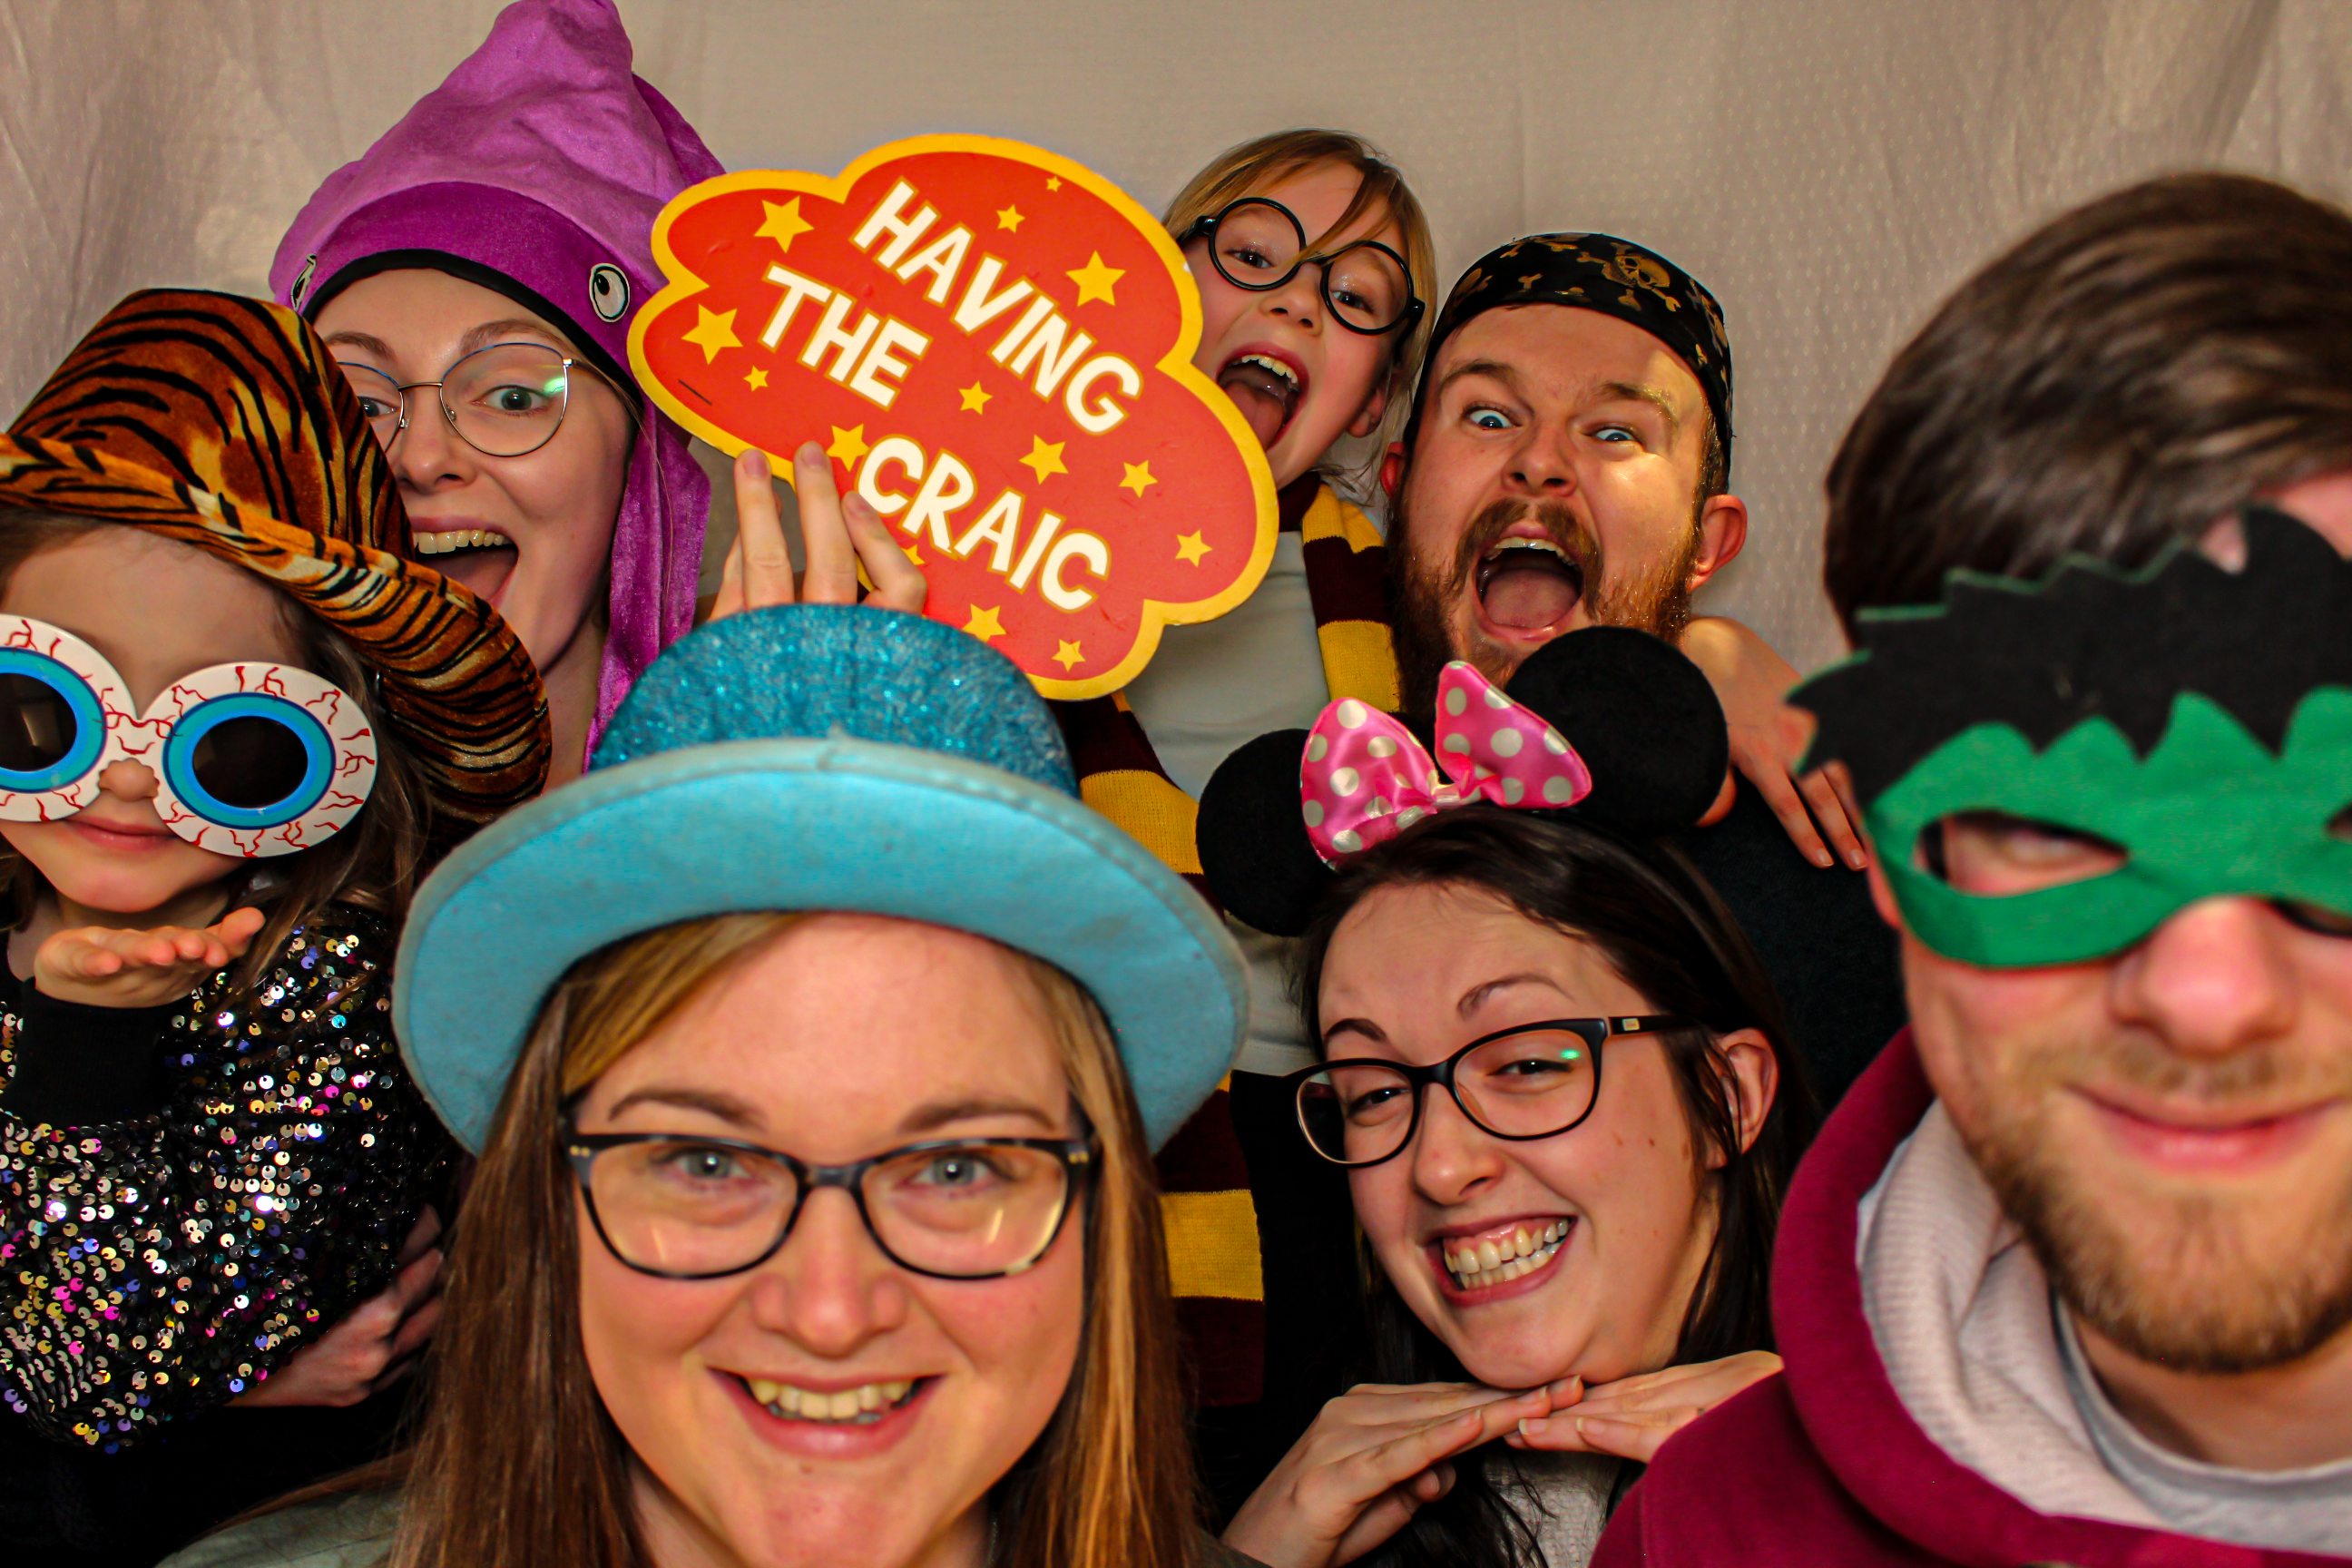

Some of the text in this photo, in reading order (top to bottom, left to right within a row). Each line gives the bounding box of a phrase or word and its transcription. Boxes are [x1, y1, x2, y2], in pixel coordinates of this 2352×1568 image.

[761, 264, 930, 408] THE
[852, 180, 1142, 434] HAVING
[858, 436, 1110, 612] CRAIC
